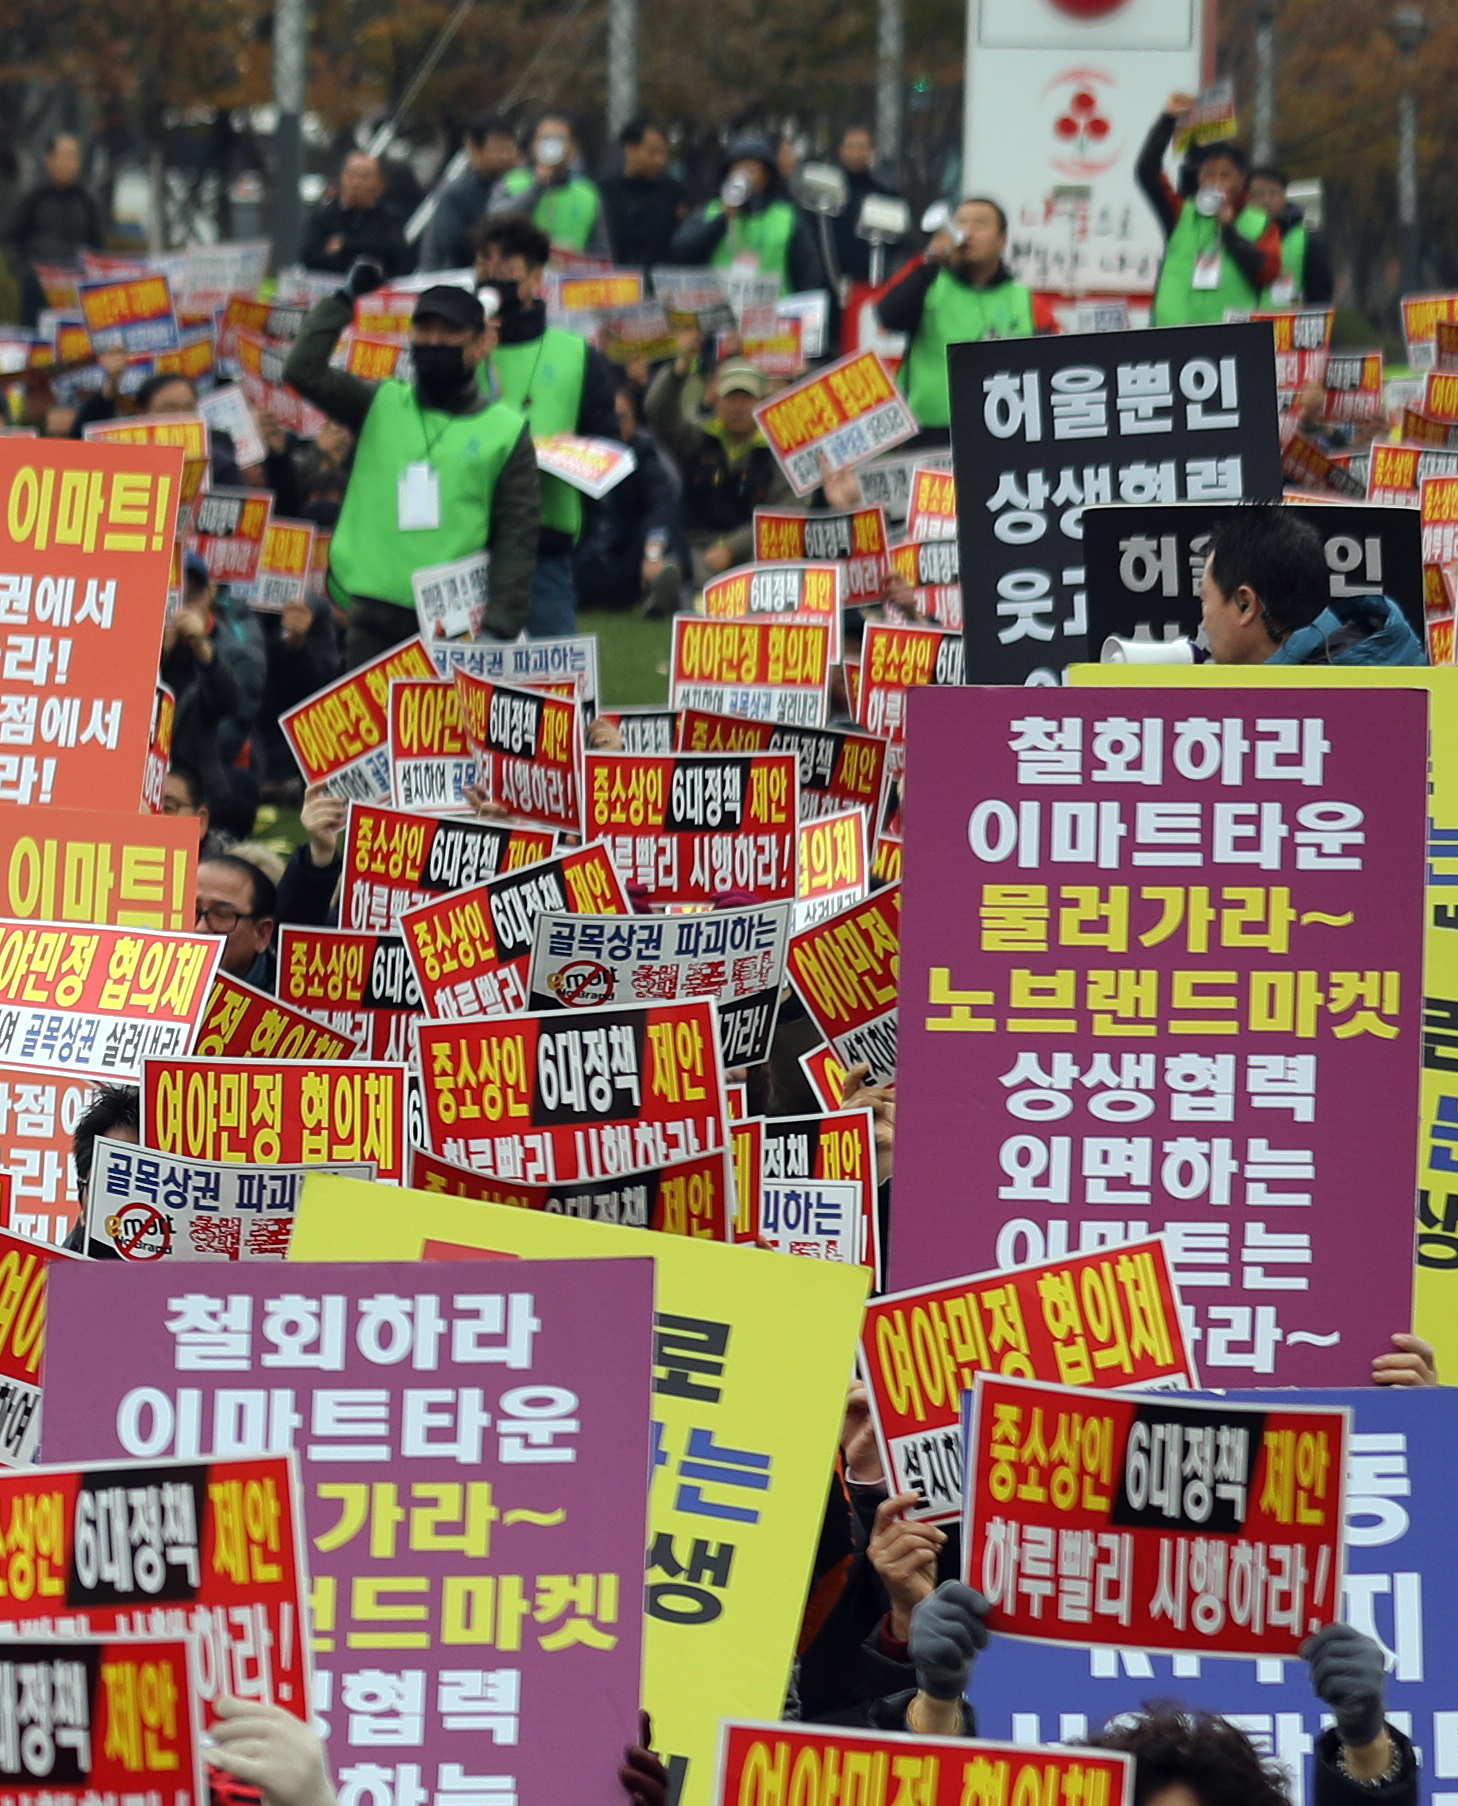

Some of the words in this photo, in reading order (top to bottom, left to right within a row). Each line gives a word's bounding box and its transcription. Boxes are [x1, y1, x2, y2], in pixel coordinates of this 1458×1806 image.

[982, 357, 1241, 443] 허울뿐인
[5, 465, 171, 553] 이마트!
[678, 626, 760, 685] 여야민정
[767, 626, 825, 687] 협의체
[489, 694, 538, 757] 6대정책
[540, 711, 573, 764] 제안
[1008, 717, 1331, 787] 철회하라
[497, 757, 576, 827] 시행하라!
[592, 763, 663, 826] 중소상인
[671, 766, 742, 820] 6대정책
[749, 763, 790, 824] 제안
[689, 837, 790, 892] 시행하라!
[968, 799, 1365, 872] 이마트타운
[548, 915, 664, 958] 골목상권
[676, 910, 777, 954] 파괴하는
[978, 884, 1354, 954] 물러가라~
[99, 936, 204, 1020] 협의체
[926, 967, 1400, 1040] 노브랜드마켓
[21, 1010, 98, 1067] 골목상권
[104, 1022, 181, 1076] 살려내라
[432, 1031, 528, 1124] 중소상인
[536, 1022, 642, 1116] 6대정책
[650, 1014, 706, 1103] 제안
[1000, 1051, 1317, 1123] 상생협력
[107, 1154, 220, 1214] 골목상권
[997, 1135, 1316, 1207] 외면하는
[164, 1292, 543, 1372] 철회하라
[1040, 1253, 1175, 1386] 협의체
[116, 1386, 582, 1465] 이마트타운
[988, 1403, 1113, 1511] 중소상인
